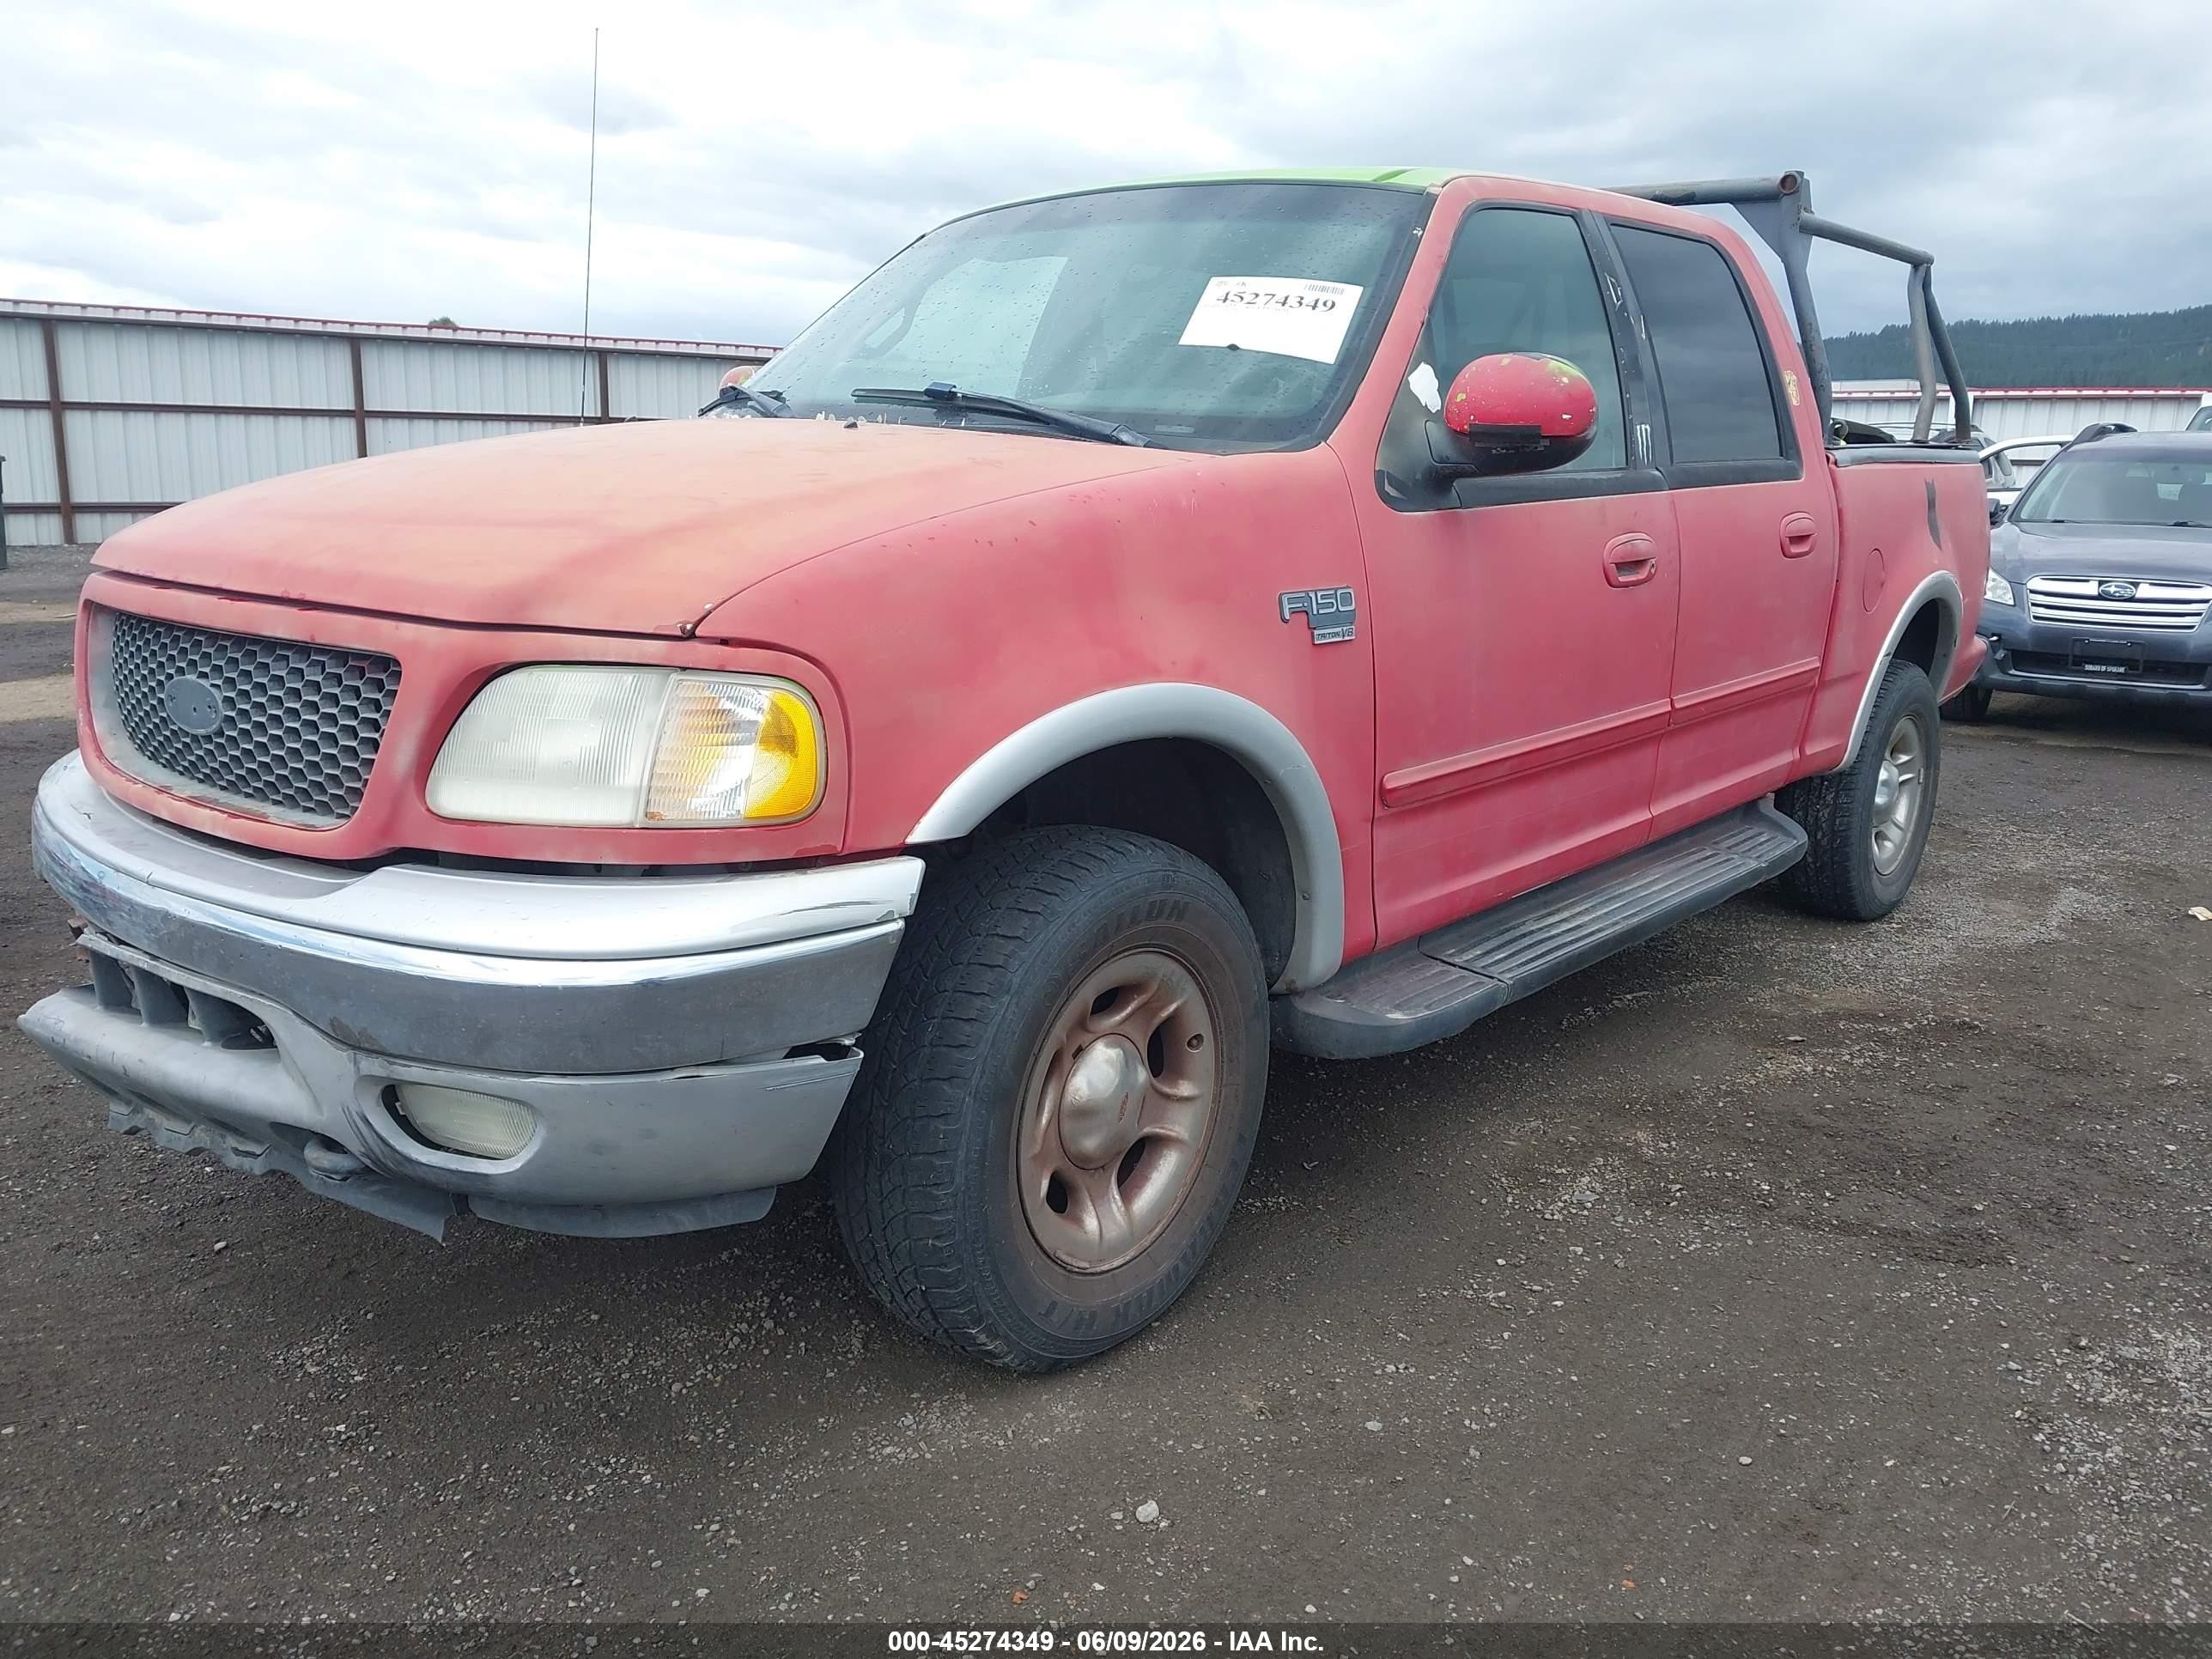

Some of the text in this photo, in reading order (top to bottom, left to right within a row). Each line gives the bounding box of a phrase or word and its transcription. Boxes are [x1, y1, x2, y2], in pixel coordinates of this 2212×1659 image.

[1216, 290, 1336, 313] 45274349
[1316, 628, 1354, 641] TRITON V8
